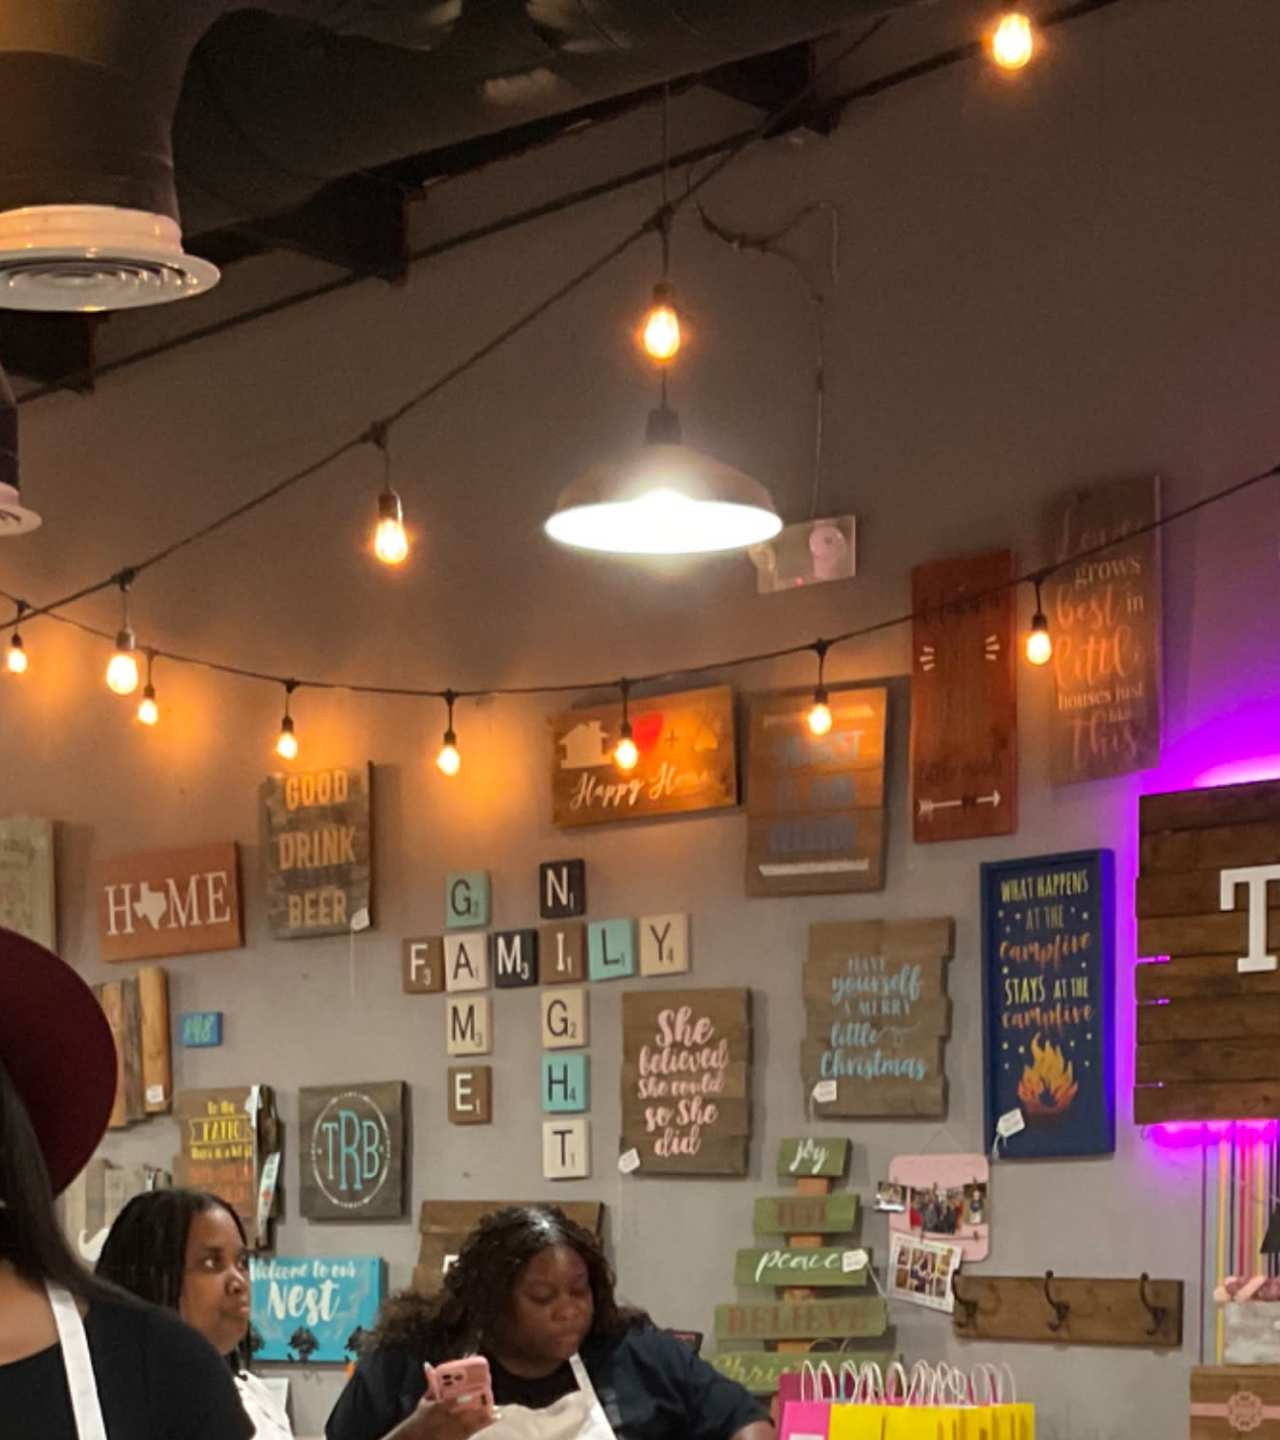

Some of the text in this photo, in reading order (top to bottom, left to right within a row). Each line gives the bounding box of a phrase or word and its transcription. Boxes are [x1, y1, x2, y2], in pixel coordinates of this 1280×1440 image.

[1075, 558, 1141, 589] grows
[1127, 592, 1144, 614] in
[286, 769, 348, 811] GOOD
[570, 772, 645, 808] Happy
[279, 826, 356, 871] DRINK
[104, 871, 231, 936] HME
[1001, 870, 1089, 902] WHAT HAPPENS
[287, 889, 347, 929] BEER
[1026, 904, 1065, 930] AT THE
[832, 964, 923, 1006] yourself
[1005, 976, 1089, 1005] STAYS AT THE
[656, 1005, 715, 1047] She
[639, 1038, 729, 1076] believed
[821, 1047, 928, 1081] Christmas
[670, 1070, 724, 1097] could
[645, 1106, 673, 1132] so
[322, 1110, 381, 1191] TRB
[654, 1124, 702, 1158] did
[789, 1138, 828, 1174] joy
[249, 1257, 357, 1282] Welcome to our
[755, 1250, 841, 1284] peace
[268, 1279, 340, 1326] Nest
